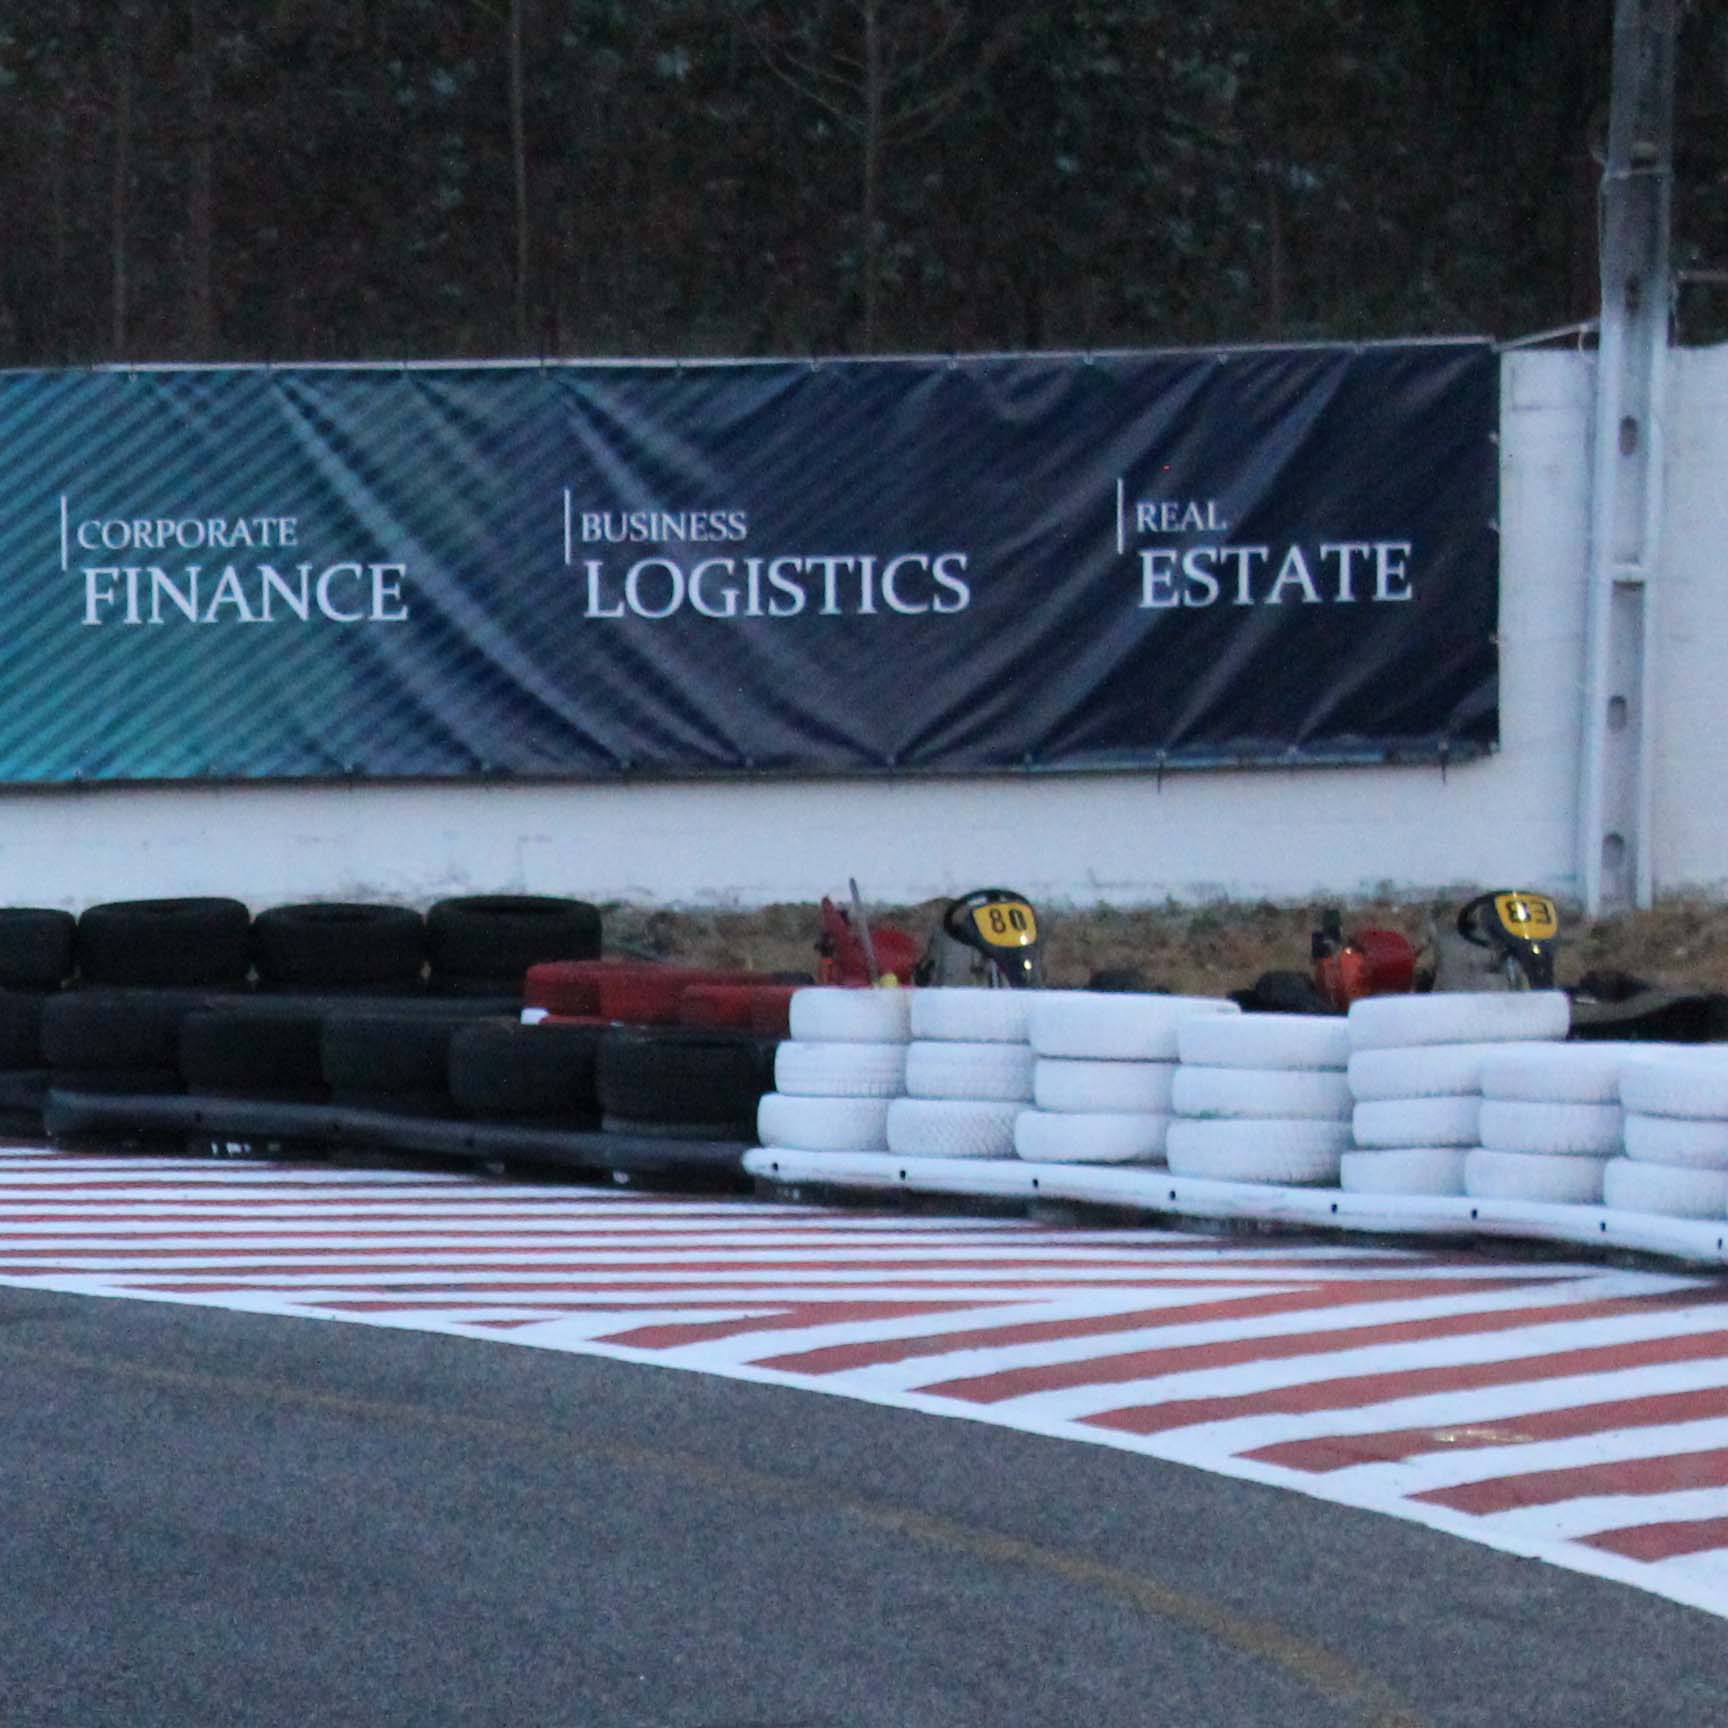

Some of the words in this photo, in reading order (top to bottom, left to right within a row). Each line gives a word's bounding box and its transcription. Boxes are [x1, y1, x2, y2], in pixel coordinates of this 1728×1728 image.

[77, 516, 299, 551] CORPORATE
[580, 510, 748, 544] BUSINESS
[1134, 500, 1229, 534] REAL
[583, 552, 971, 620] LOGISTICS
[1138, 541, 1413, 610] ESTATE
[81, 562, 410, 626] FINANCE
[990, 907, 1028, 934] 80
